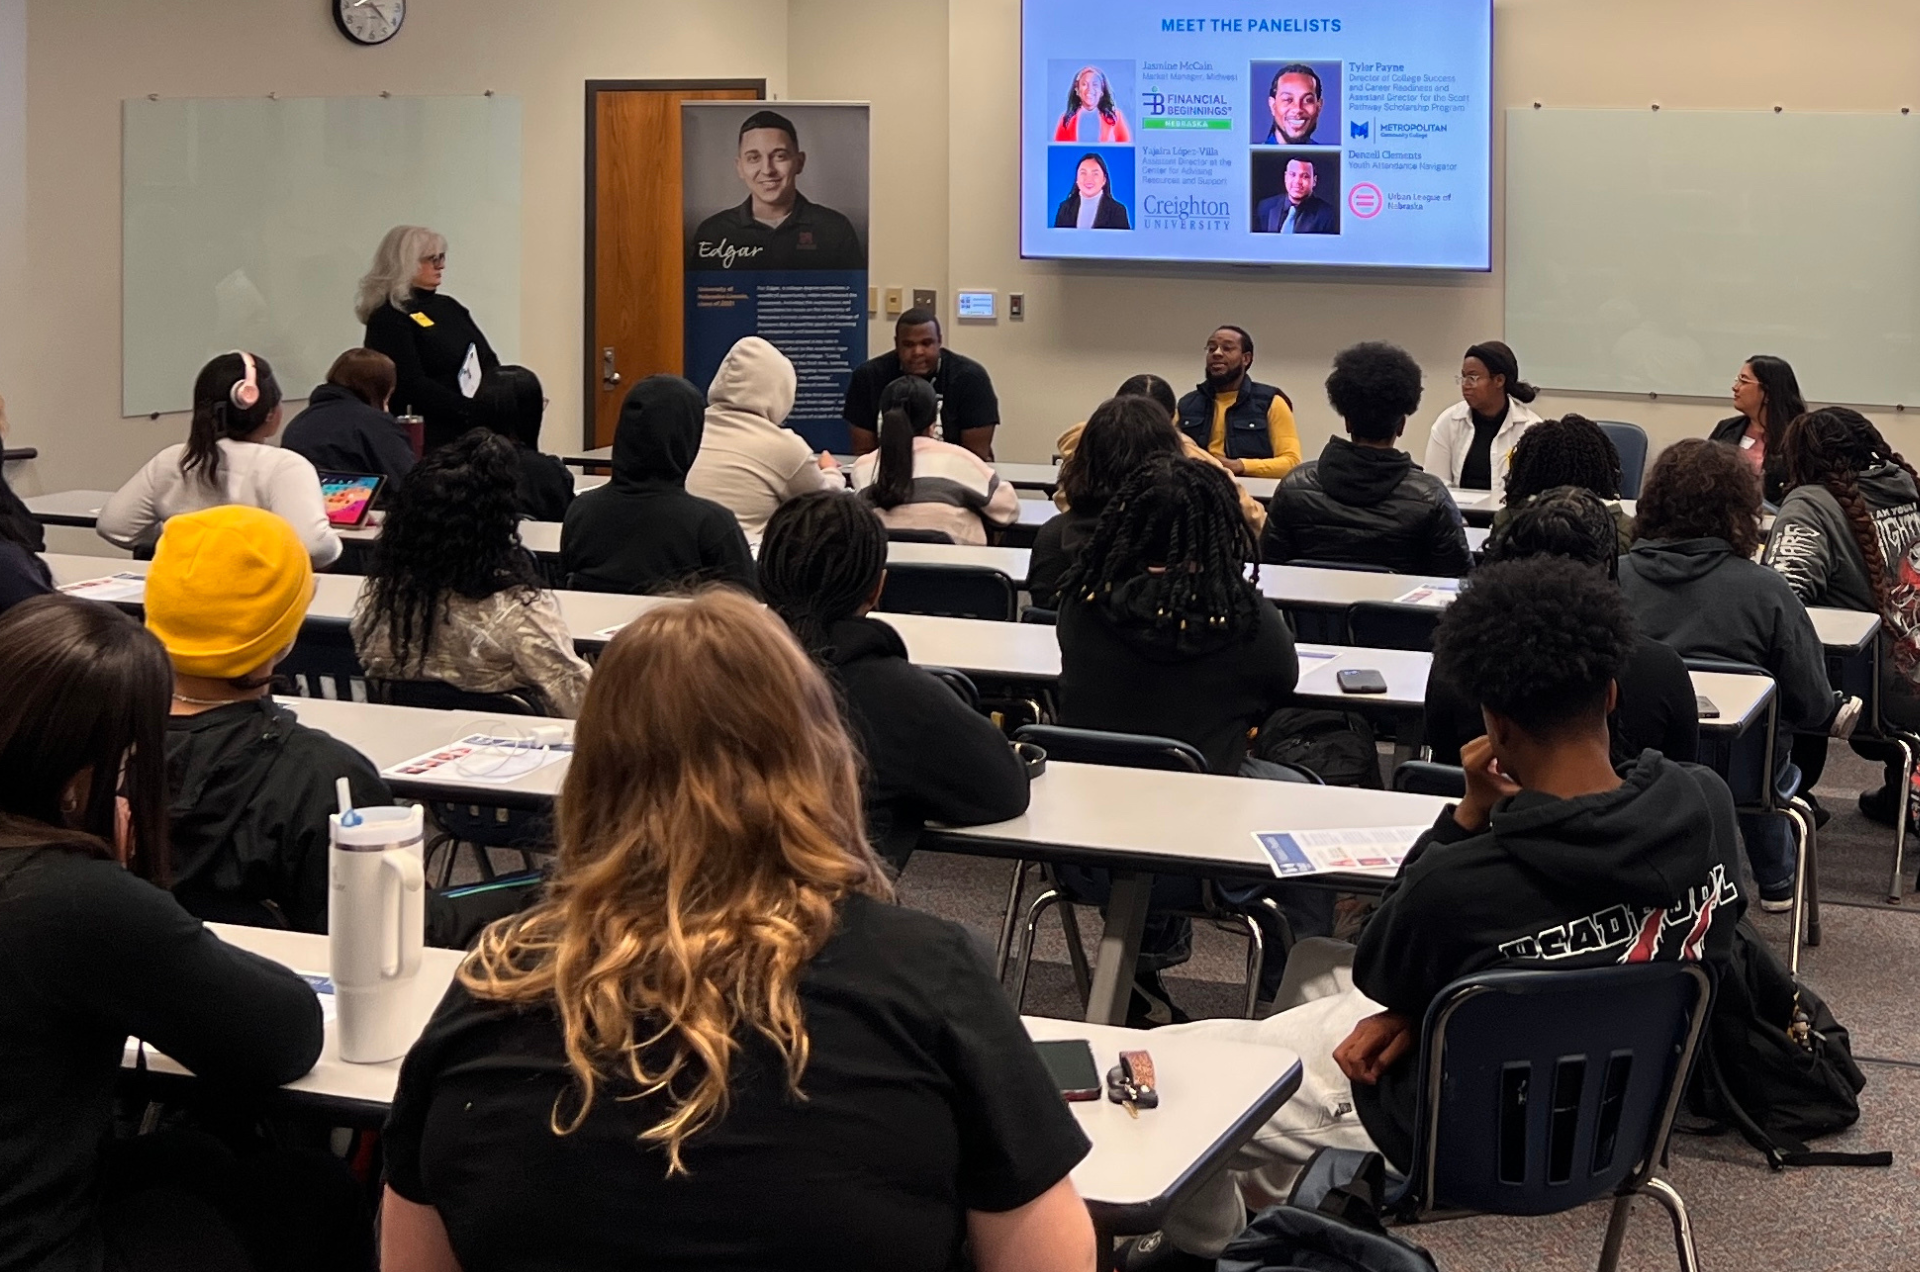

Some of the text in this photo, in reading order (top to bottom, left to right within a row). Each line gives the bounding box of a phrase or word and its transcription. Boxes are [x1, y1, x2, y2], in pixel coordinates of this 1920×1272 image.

[1161, 18, 1342, 32] MEET THE PANELISTS
[1142, 61, 1213, 70] Jasmine McCain
[1348, 62, 1404, 73] Tyler Payne
[1349, 74, 1456, 83] Director of College Success
[1349, 84, 1449, 92] and Career Readiness and
[1167, 94, 1227, 105] FINANCIAL
[1349, 93, 1384, 101] Assistant
[1420, 93, 1431, 102] for
[1433, 93, 1447, 102] the
[1448, 94, 1470, 102] Scott
[1383, 103, 1429, 112] Scholarship
[1431, 103, 1465, 113] Program
[1165, 120, 1209, 128] NEBRASKA
[1380, 124, 1447, 132] METROPOLITAN
[1381, 150, 1422, 160] Clements
[1219, 158, 1232, 166] the
[1349, 161, 1457, 171] Youth Attendance Navigator
[1182, 176, 1196, 185] and
[1197, 177, 1228, 186] Support
[1387, 193, 1452, 202] Urban League of
[1144, 194, 1230, 220] Creighton
[1387, 202, 1424, 210] Nebraska
[1144, 219, 1230, 230] UNIVERSITY
[698, 238, 763, 269] Edgar
